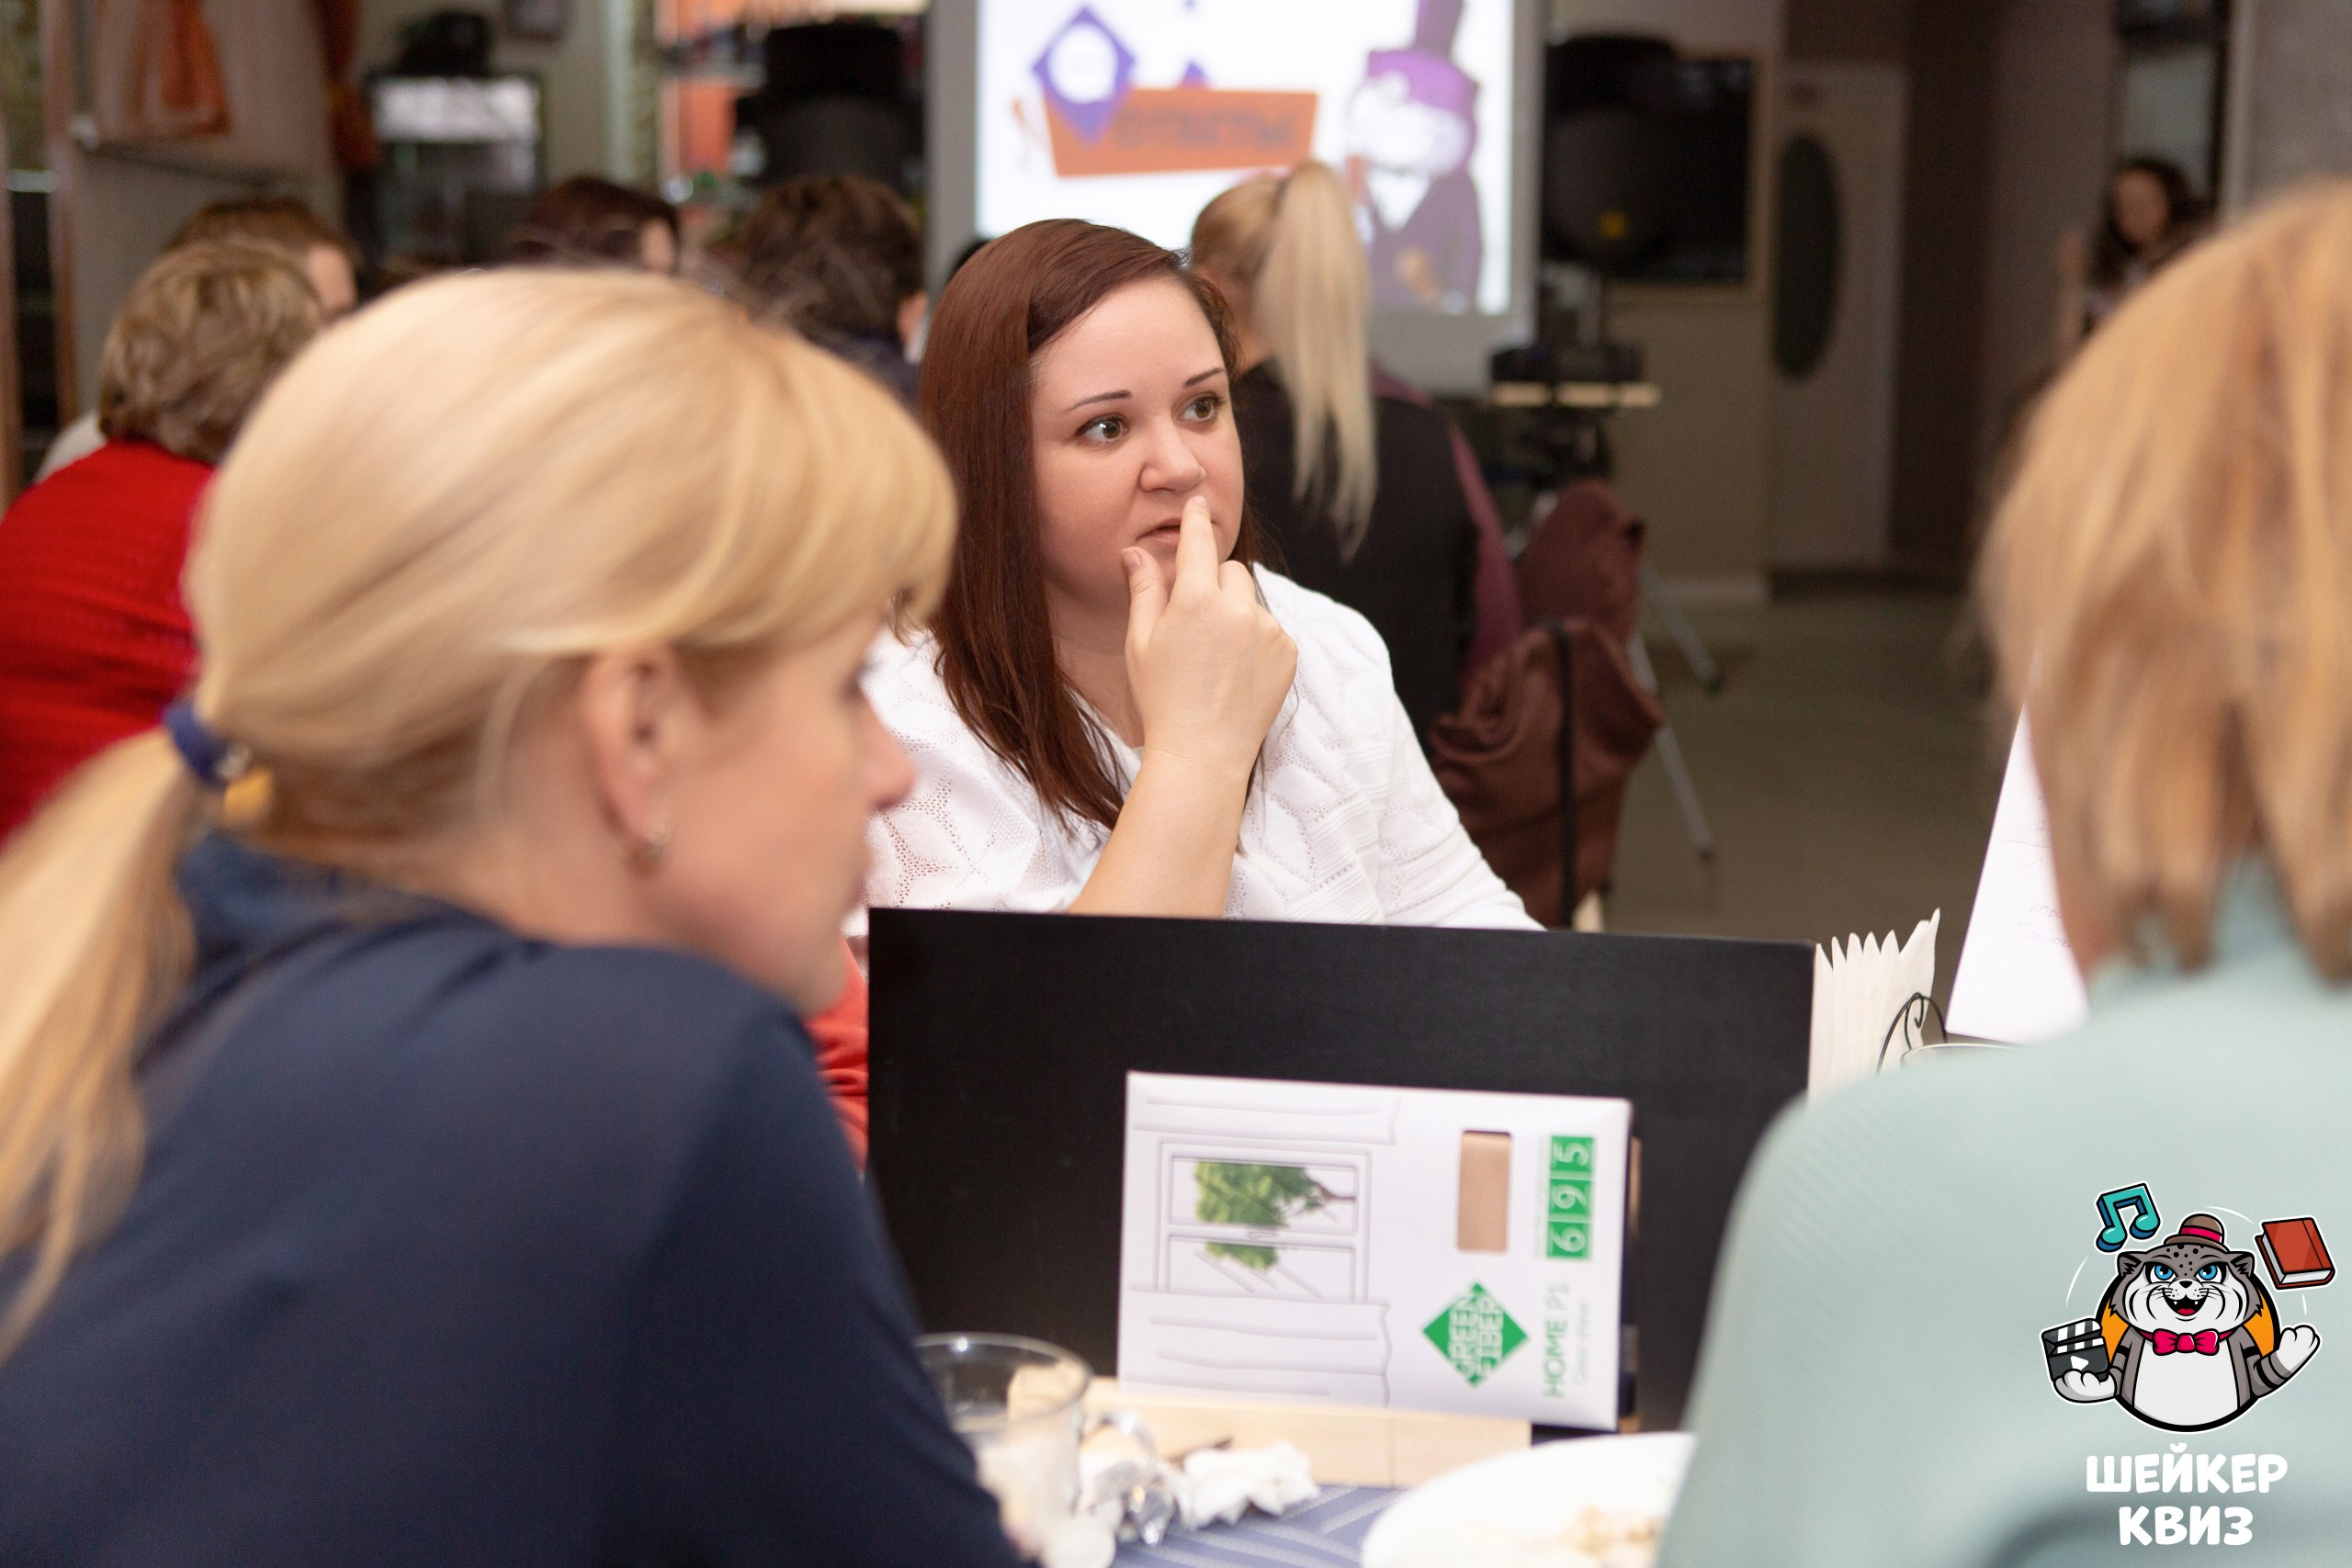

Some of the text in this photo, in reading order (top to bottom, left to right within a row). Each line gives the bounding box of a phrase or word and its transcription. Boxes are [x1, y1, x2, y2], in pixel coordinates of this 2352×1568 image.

[1550, 1140, 1591, 1254] 695
[1448, 1296, 1477, 1375] GREEN
[1477, 1292, 1504, 1371] FIBER
[1544, 1319, 1568, 1398] HOME
